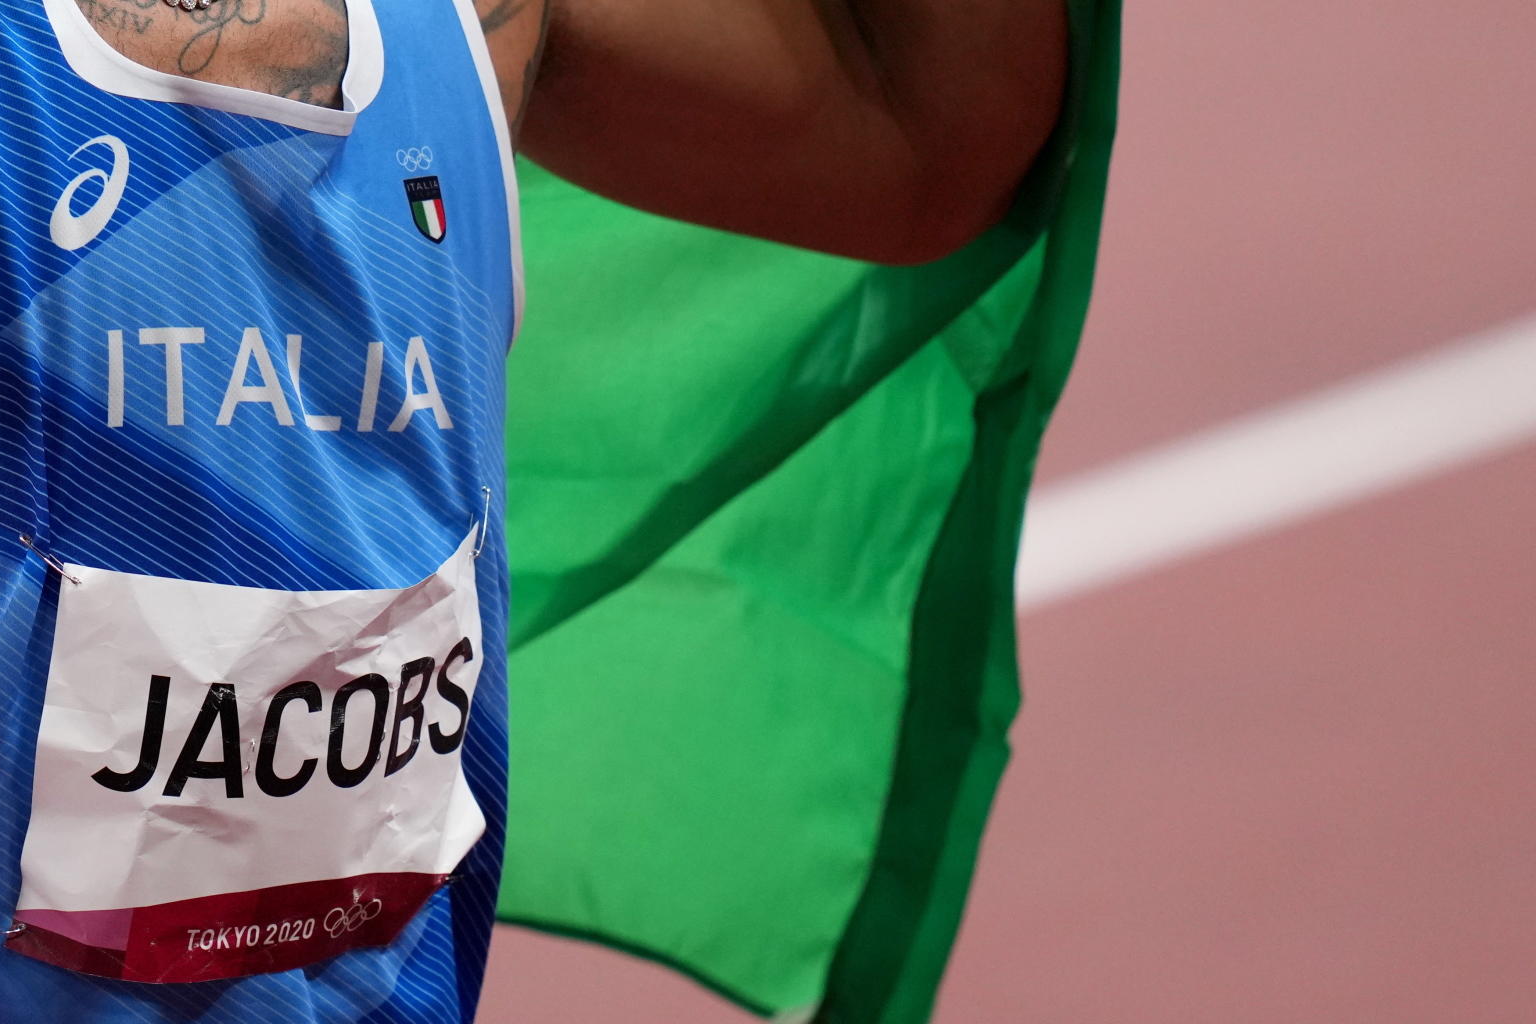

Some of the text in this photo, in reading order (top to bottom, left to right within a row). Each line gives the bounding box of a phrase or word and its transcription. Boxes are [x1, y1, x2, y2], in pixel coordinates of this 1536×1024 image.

[407, 180, 439, 192] ITALIA
[106, 326, 455, 433] ITALIA
[90, 636, 474, 799] JACOBS
[186, 917, 316, 952] TOKYO 2020
